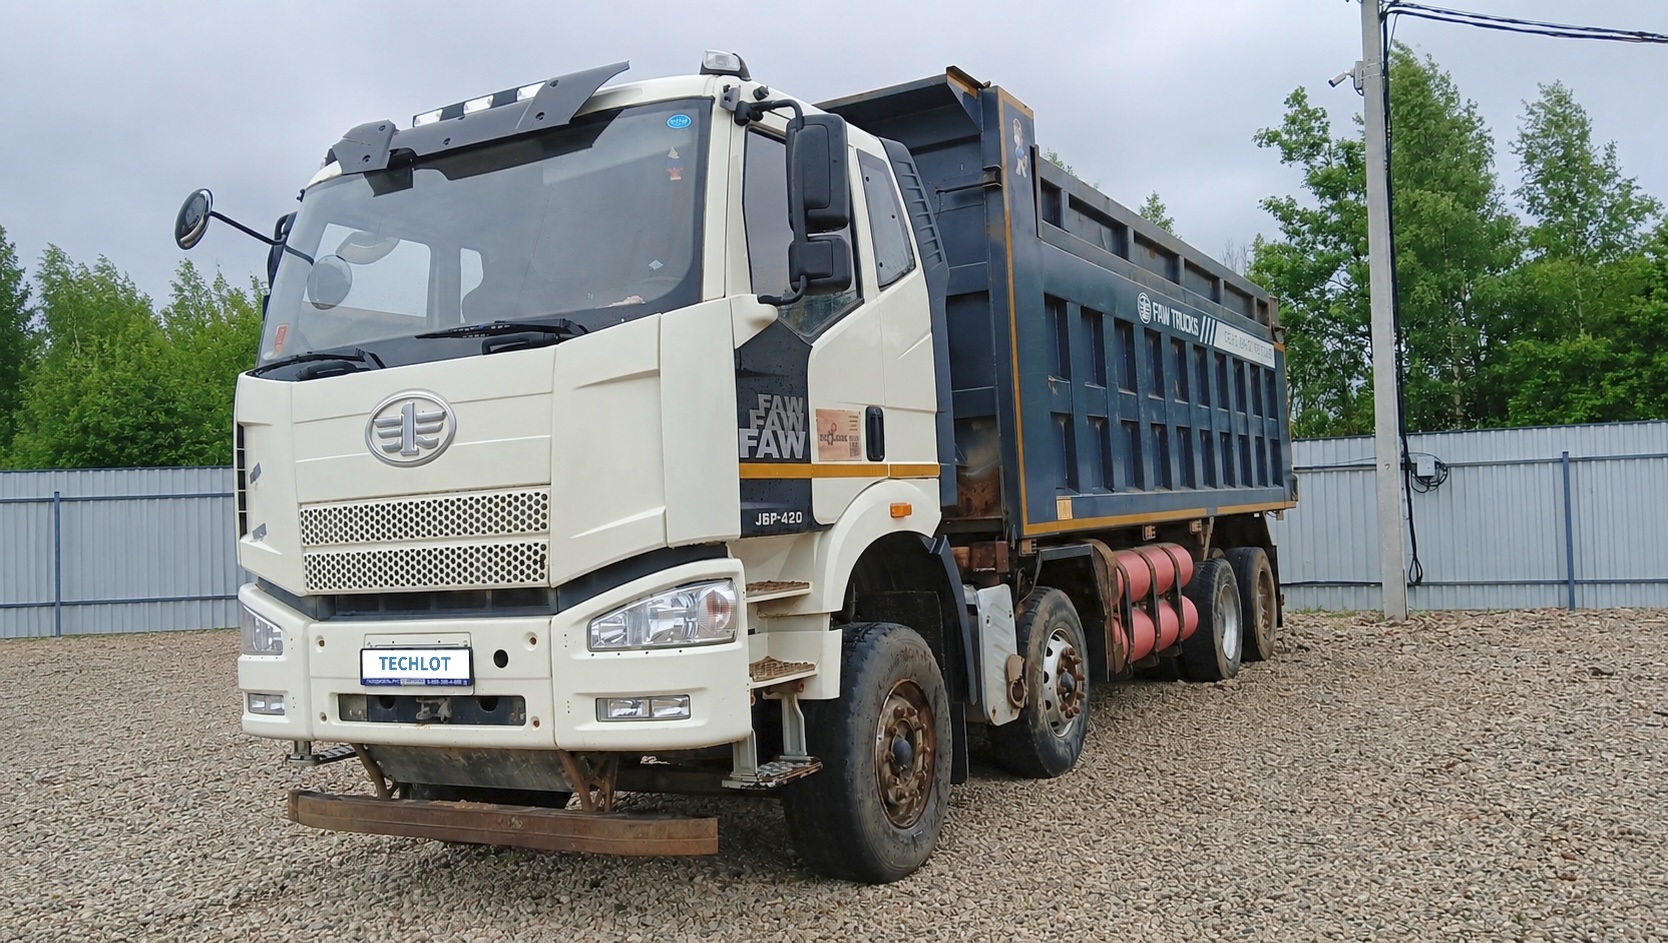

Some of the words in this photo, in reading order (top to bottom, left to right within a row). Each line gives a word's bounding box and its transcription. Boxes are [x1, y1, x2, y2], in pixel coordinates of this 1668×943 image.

[1152, 301, 1170, 326] FAW
[1171, 308, 1199, 336] TRUCKS
[757, 393, 803, 417] FAW
[749, 409, 804, 435] FAW
[738, 428, 806, 459] FAW
